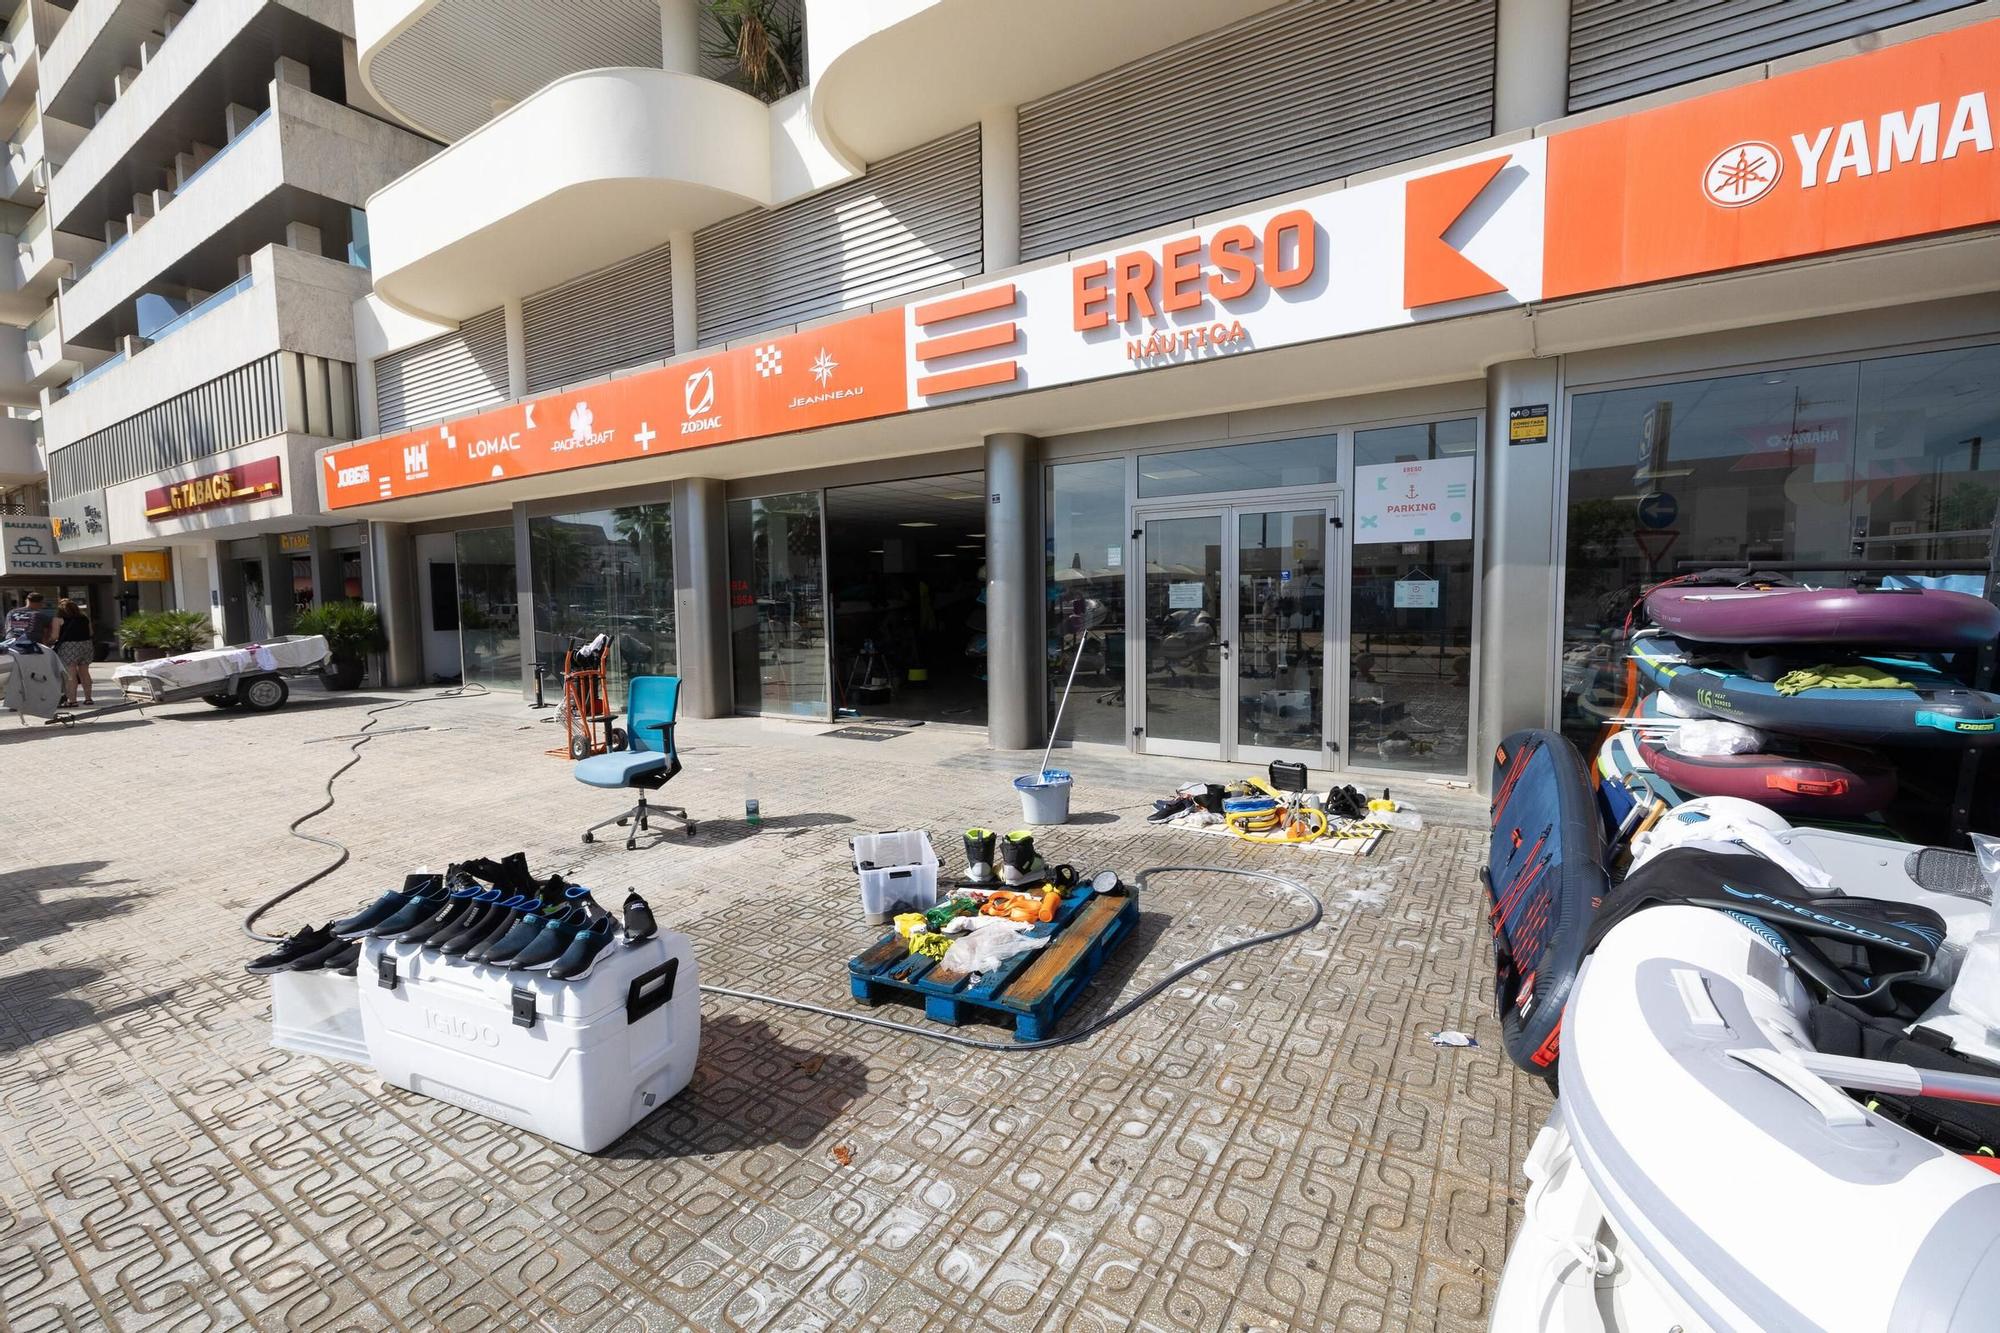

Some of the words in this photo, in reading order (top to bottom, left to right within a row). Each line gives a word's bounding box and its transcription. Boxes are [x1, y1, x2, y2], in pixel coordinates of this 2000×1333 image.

[1073, 209, 1316, 333] ERESO
[1126, 319, 1247, 361] NÁUTICA
[788, 386, 864, 409] JEANNEAU
[681, 415, 723, 435] ZODIAC
[467, 432, 521, 459] LOMAC
[552, 437, 584, 453] PACIFIC
[584, 429, 616, 447] CRAFT
[403, 443, 429, 475] HH
[181, 473, 232, 507] TABACS
[1387, 503, 1437, 513] PARKING
[10, 560, 63, 568] TICKETS
[65, 561, 104, 569] FERRY
[1753, 894, 1910, 947] FREEDOM
[424, 1007, 502, 1049] IGLOO
